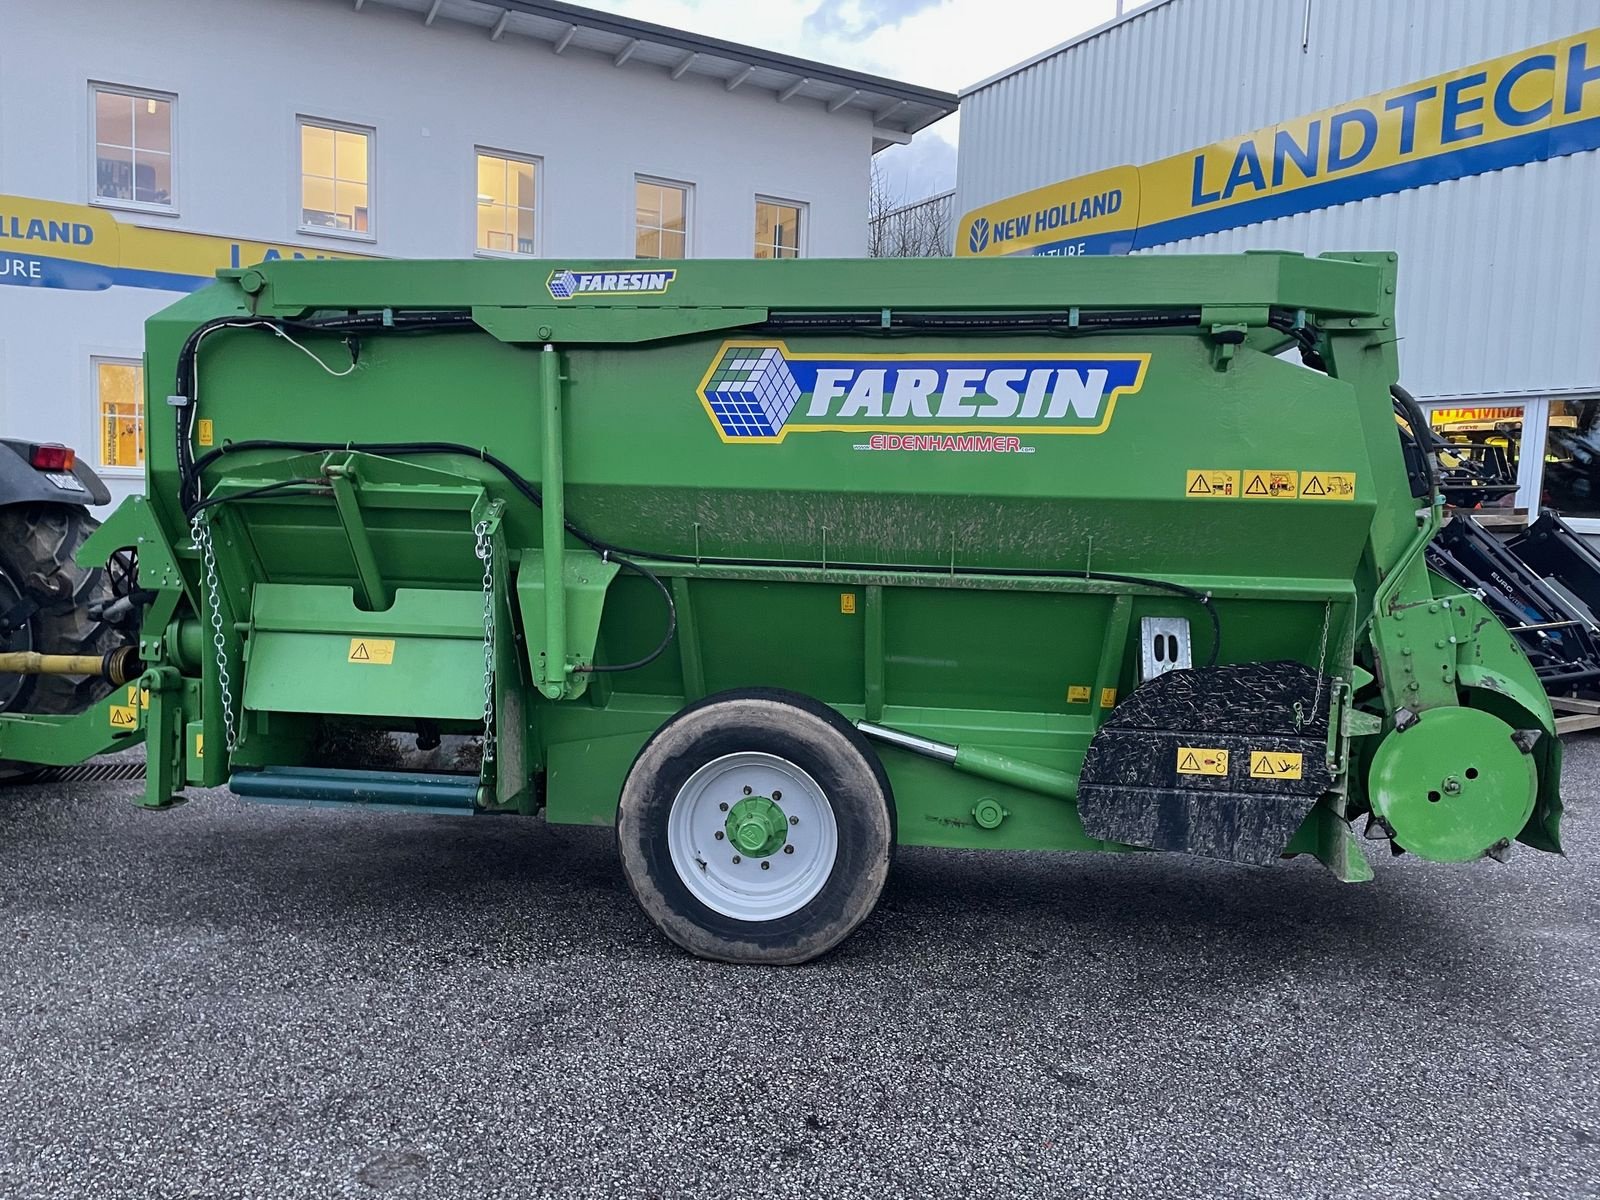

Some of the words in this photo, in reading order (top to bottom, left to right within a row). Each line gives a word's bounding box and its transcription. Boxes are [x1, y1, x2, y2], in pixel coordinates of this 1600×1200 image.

[993, 214, 1032, 243] NEW
[1035, 189, 1122, 233] HOLLAND
[578, 273, 666, 291] FARESIN
[806, 368, 1109, 418] FARESIN
[1490, 571, 1514, 593] EURO
